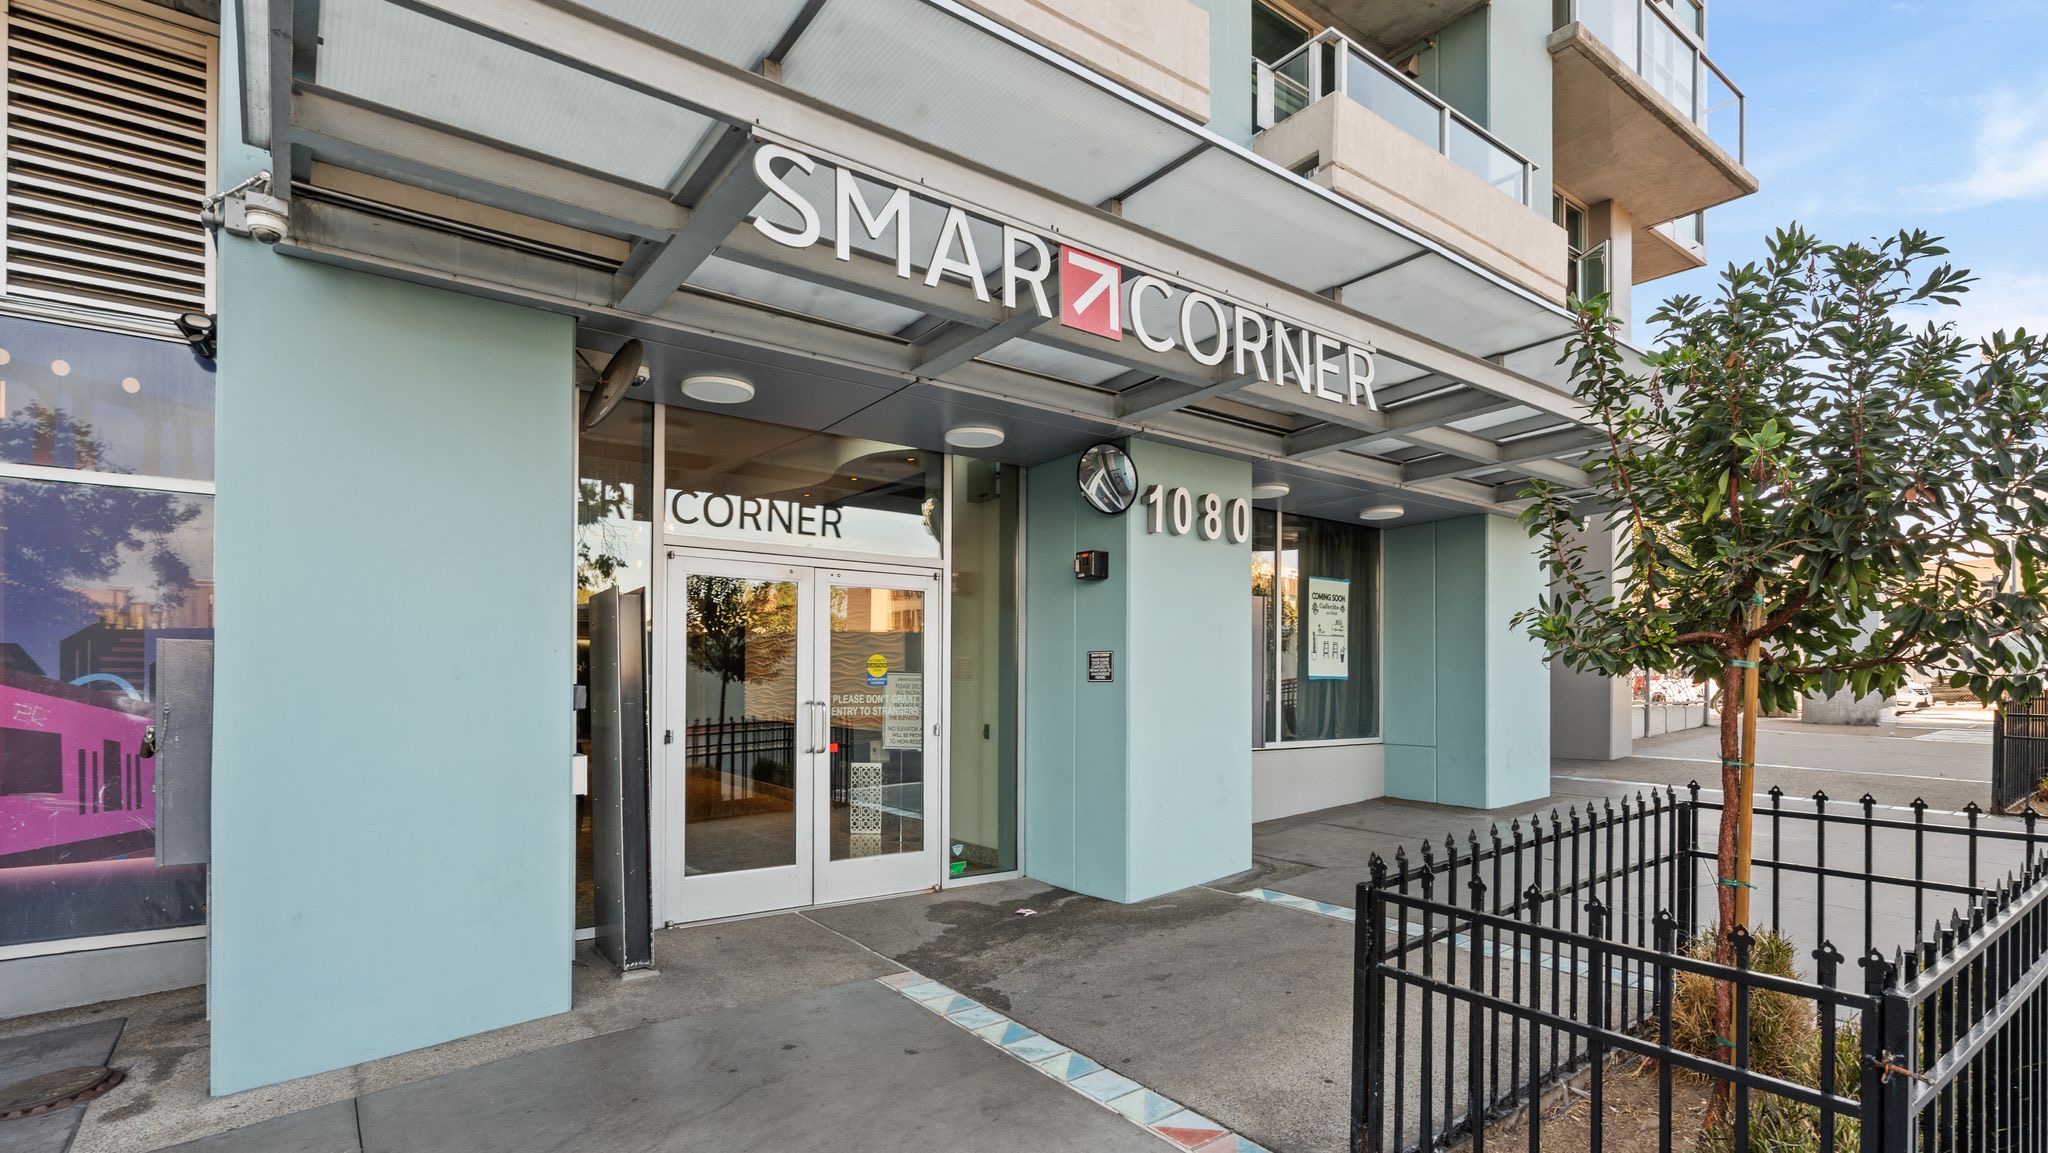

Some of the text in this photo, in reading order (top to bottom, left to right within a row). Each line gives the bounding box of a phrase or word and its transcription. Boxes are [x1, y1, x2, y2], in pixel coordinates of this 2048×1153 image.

[1129, 274, 1378, 411] CORNER
[671, 491, 842, 539] CORNER
[1141, 484, 1249, 545] 1080
[1312, 592, 1346, 603] COMING SOON
[831, 706, 858, 716] ENTRY
[860, 706, 870, 716] TO
[832, 694, 864, 704] PLEASE
[866, 694, 889, 704] DON'T
